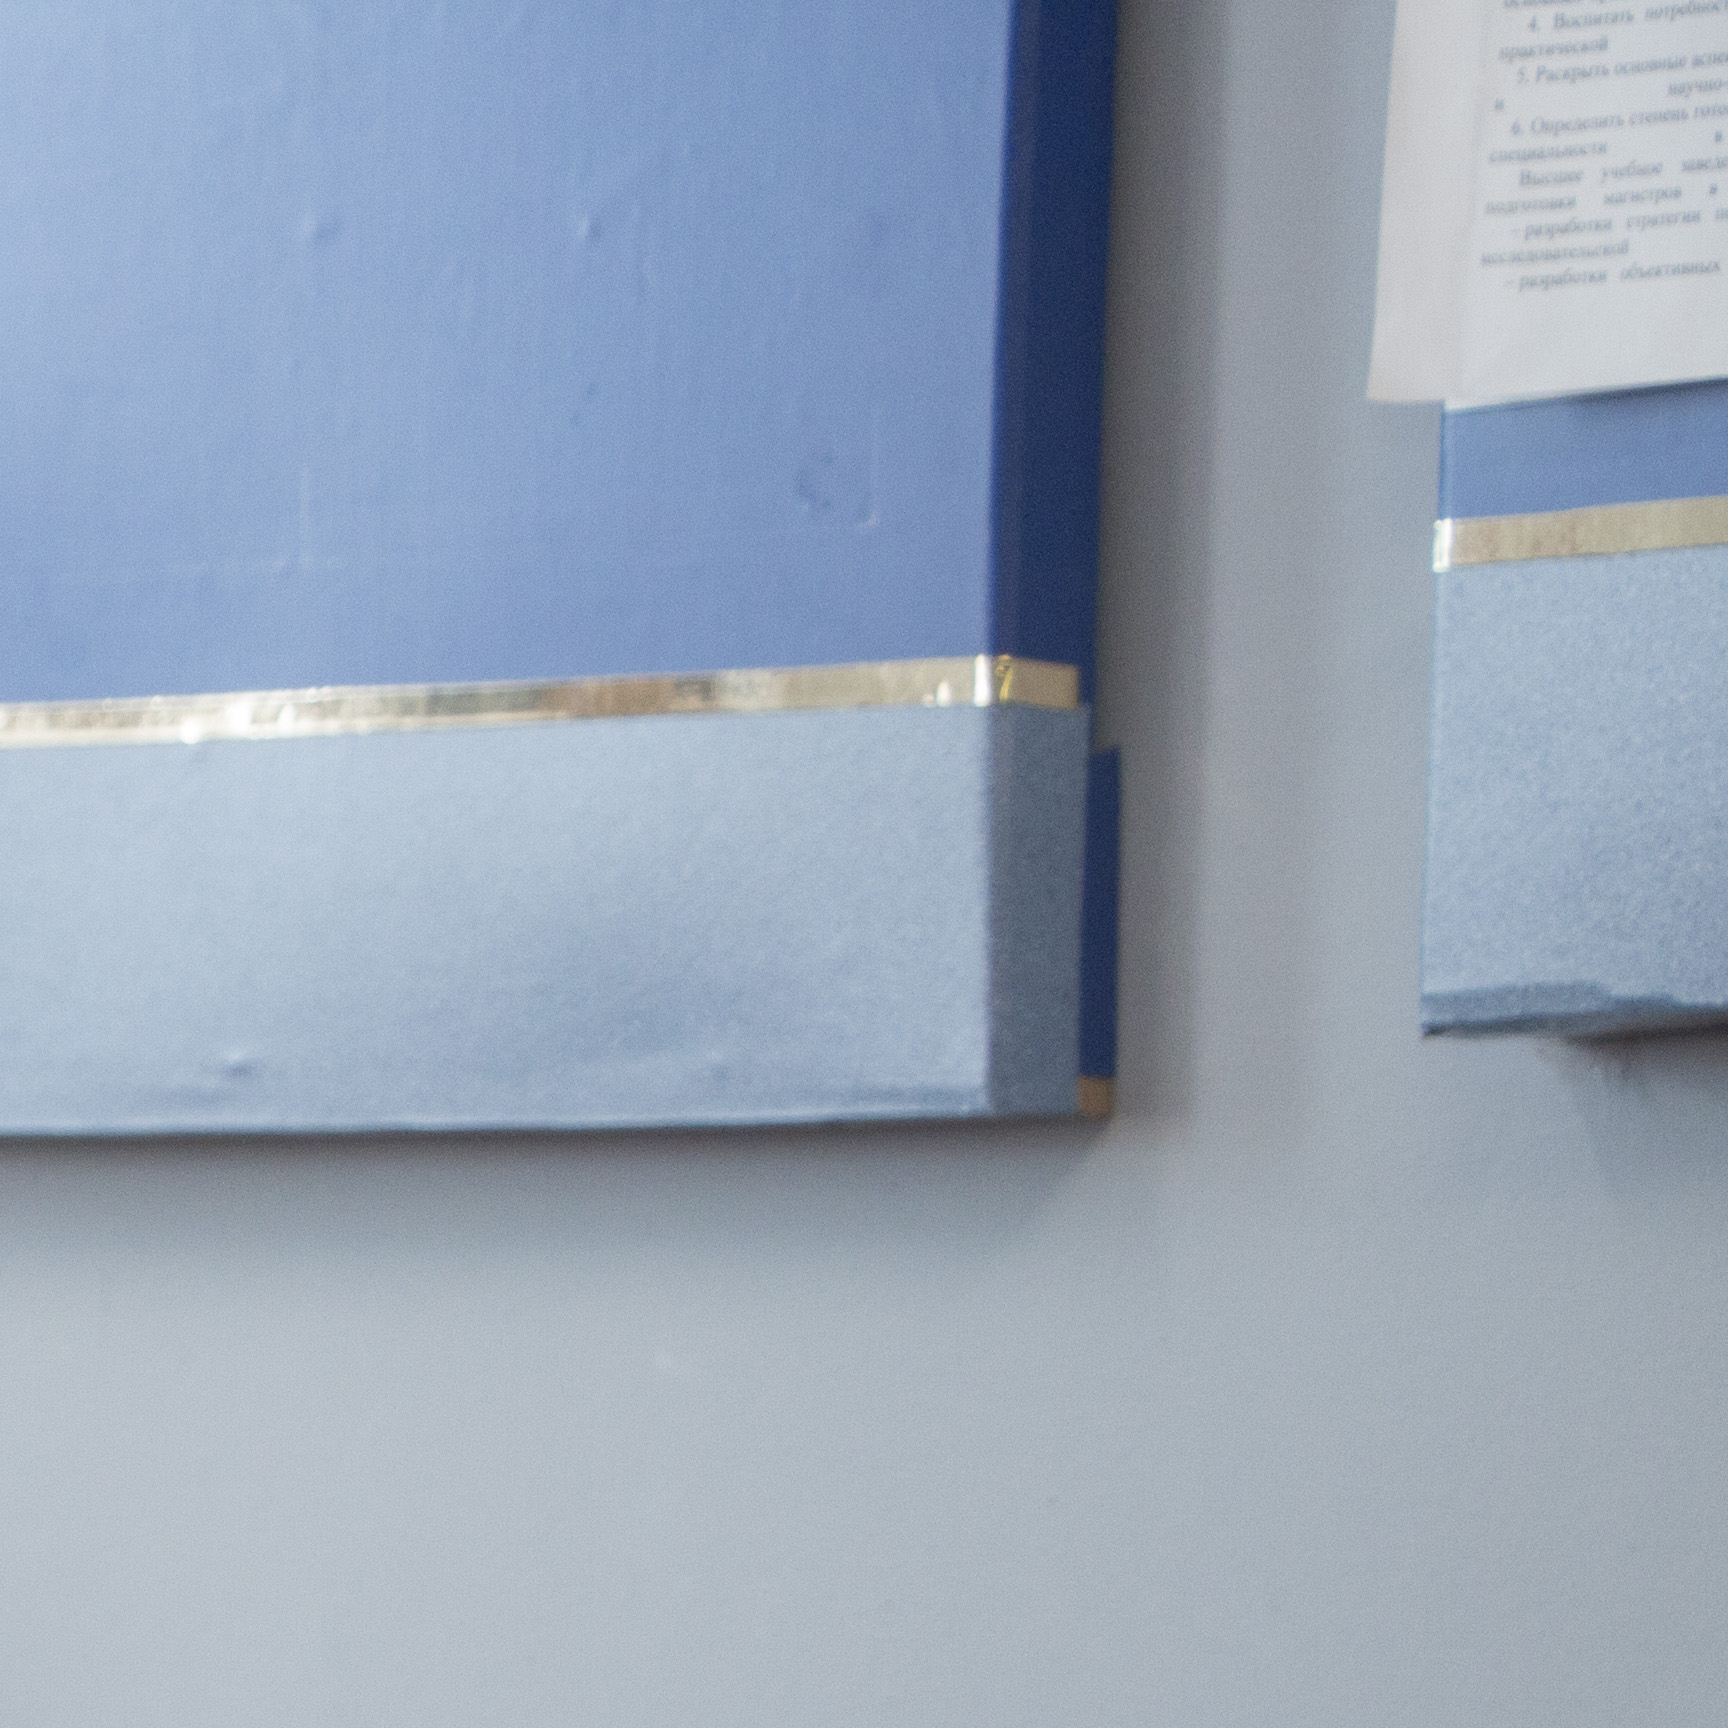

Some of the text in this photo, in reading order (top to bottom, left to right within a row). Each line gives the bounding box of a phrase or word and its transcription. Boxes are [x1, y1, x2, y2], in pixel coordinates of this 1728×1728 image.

[1553, 10, 1635, 29] Воспитать
[1535, 62, 1610, 85] Раскрыть
[1614, 56, 1687, 76] основные
[1530, 112, 1624, 138] Определить
[1629, 107, 1688, 125] степень
[1489, 141, 1607, 164] специальности
[1520, 168, 1584, 188] Высшее
[1601, 158, 1663, 183] учебное
[1484, 195, 1577, 216] подготовки
[1603, 185, 1682, 205] магистров
[1524, 217, 1613, 241] разработки
[1626, 210, 1702, 230] стратегии
[1481, 239, 1629, 264] исследовательской
[1518, 267, 1606, 291] разработки
[1621, 261, 1721, 282] объективных
